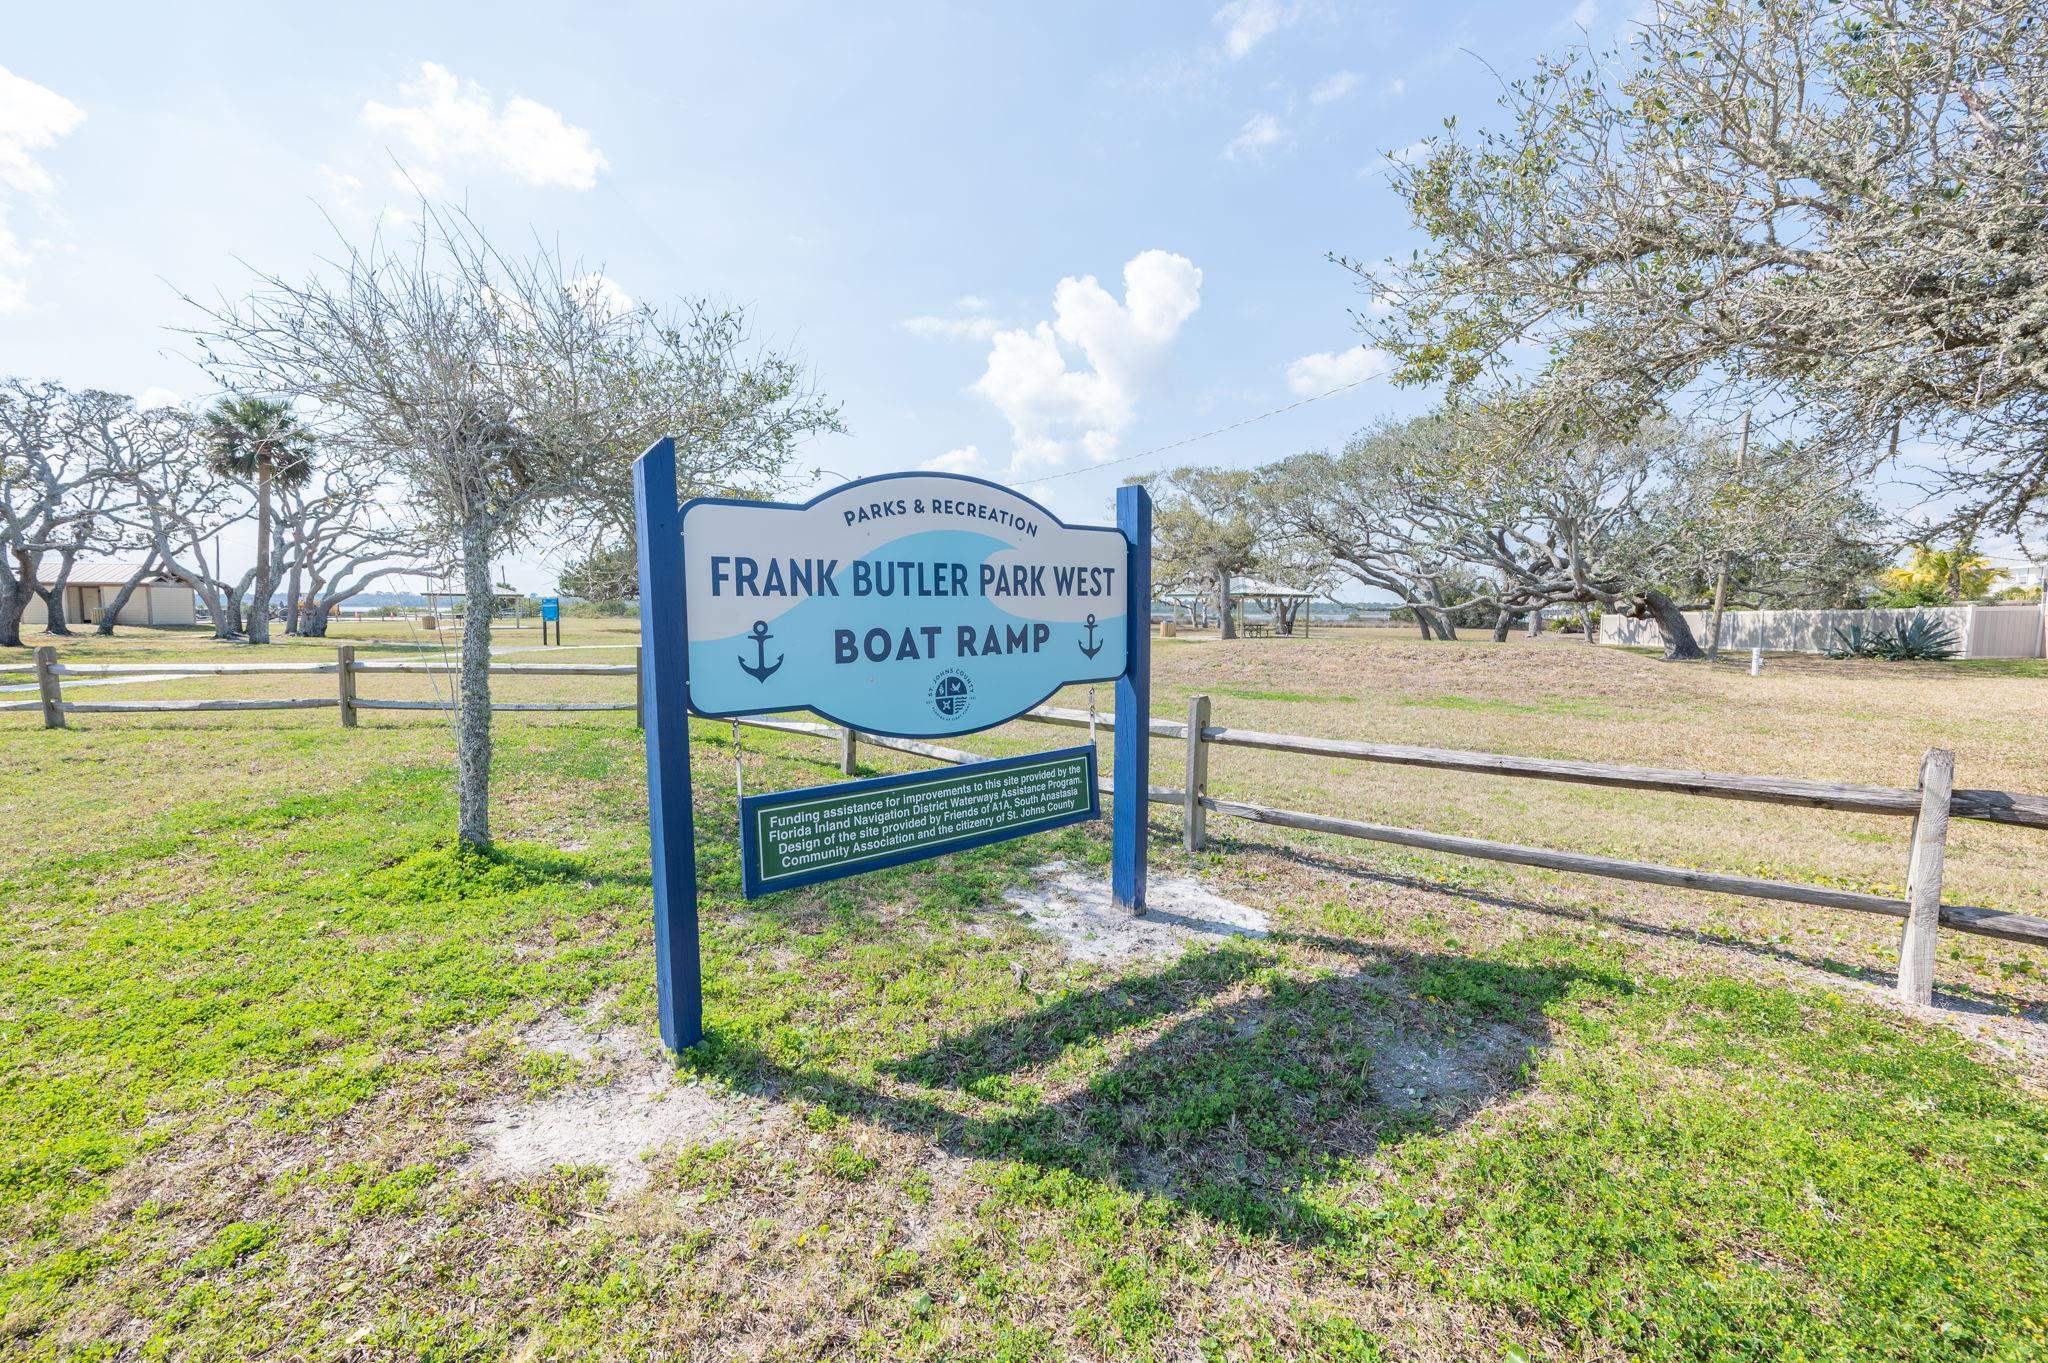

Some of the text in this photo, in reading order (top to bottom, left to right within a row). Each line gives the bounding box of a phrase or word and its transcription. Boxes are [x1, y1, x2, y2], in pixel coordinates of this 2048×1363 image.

[844, 499, 1038, 537] PARKS & RECREATION
[711, 555, 1116, 597] FRANK BUTLER PARK WEST
[834, 623, 1051, 665] BOAT RAMP
[933, 667, 954, 684] JOHNS
[955, 668, 974, 693] COUNTY
[769, 776, 1082, 842] Florida Inland Navigation District Waterways Assistance Program.
[770, 765, 1081, 828] Funding assistance for improvements to this site provided by the
[779, 787, 1078, 855] Design of the site provided by Friends of A1A, South Anastasia
[781, 799, 1075, 868] Community Association and the citizenry of St. Johns County
